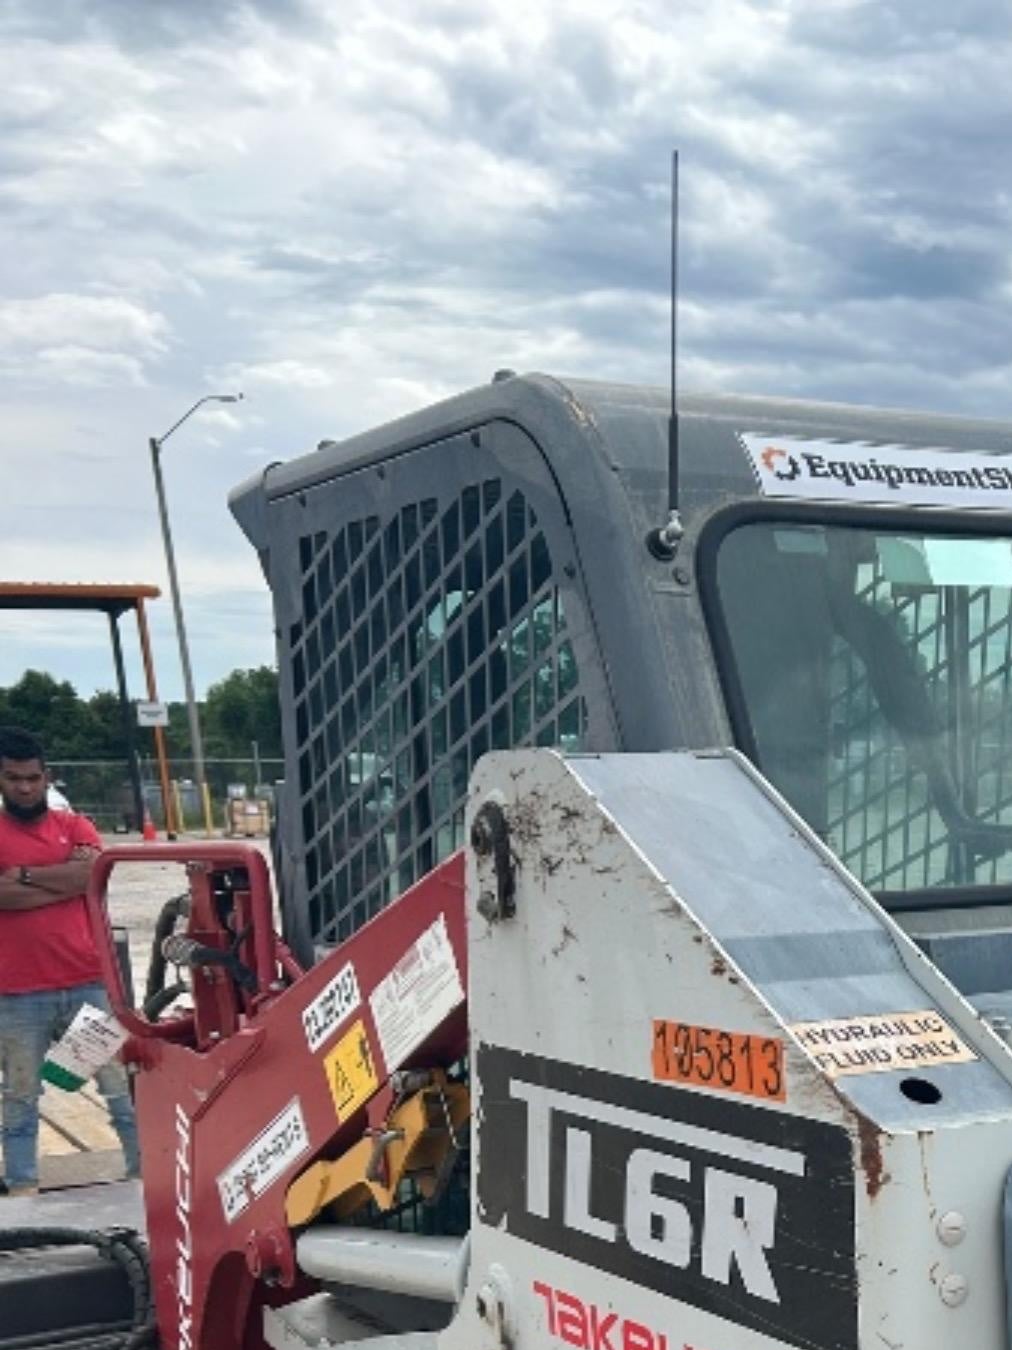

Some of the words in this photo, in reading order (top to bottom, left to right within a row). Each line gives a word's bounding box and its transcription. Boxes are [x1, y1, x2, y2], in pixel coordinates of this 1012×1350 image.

[795, 1016, 943, 1047] HYDRAULIC
[814, 1048, 892, 1069] FLUID
[896, 1039, 961, 1061] ONLY
[509, 1079, 806, 1304] TL6R
